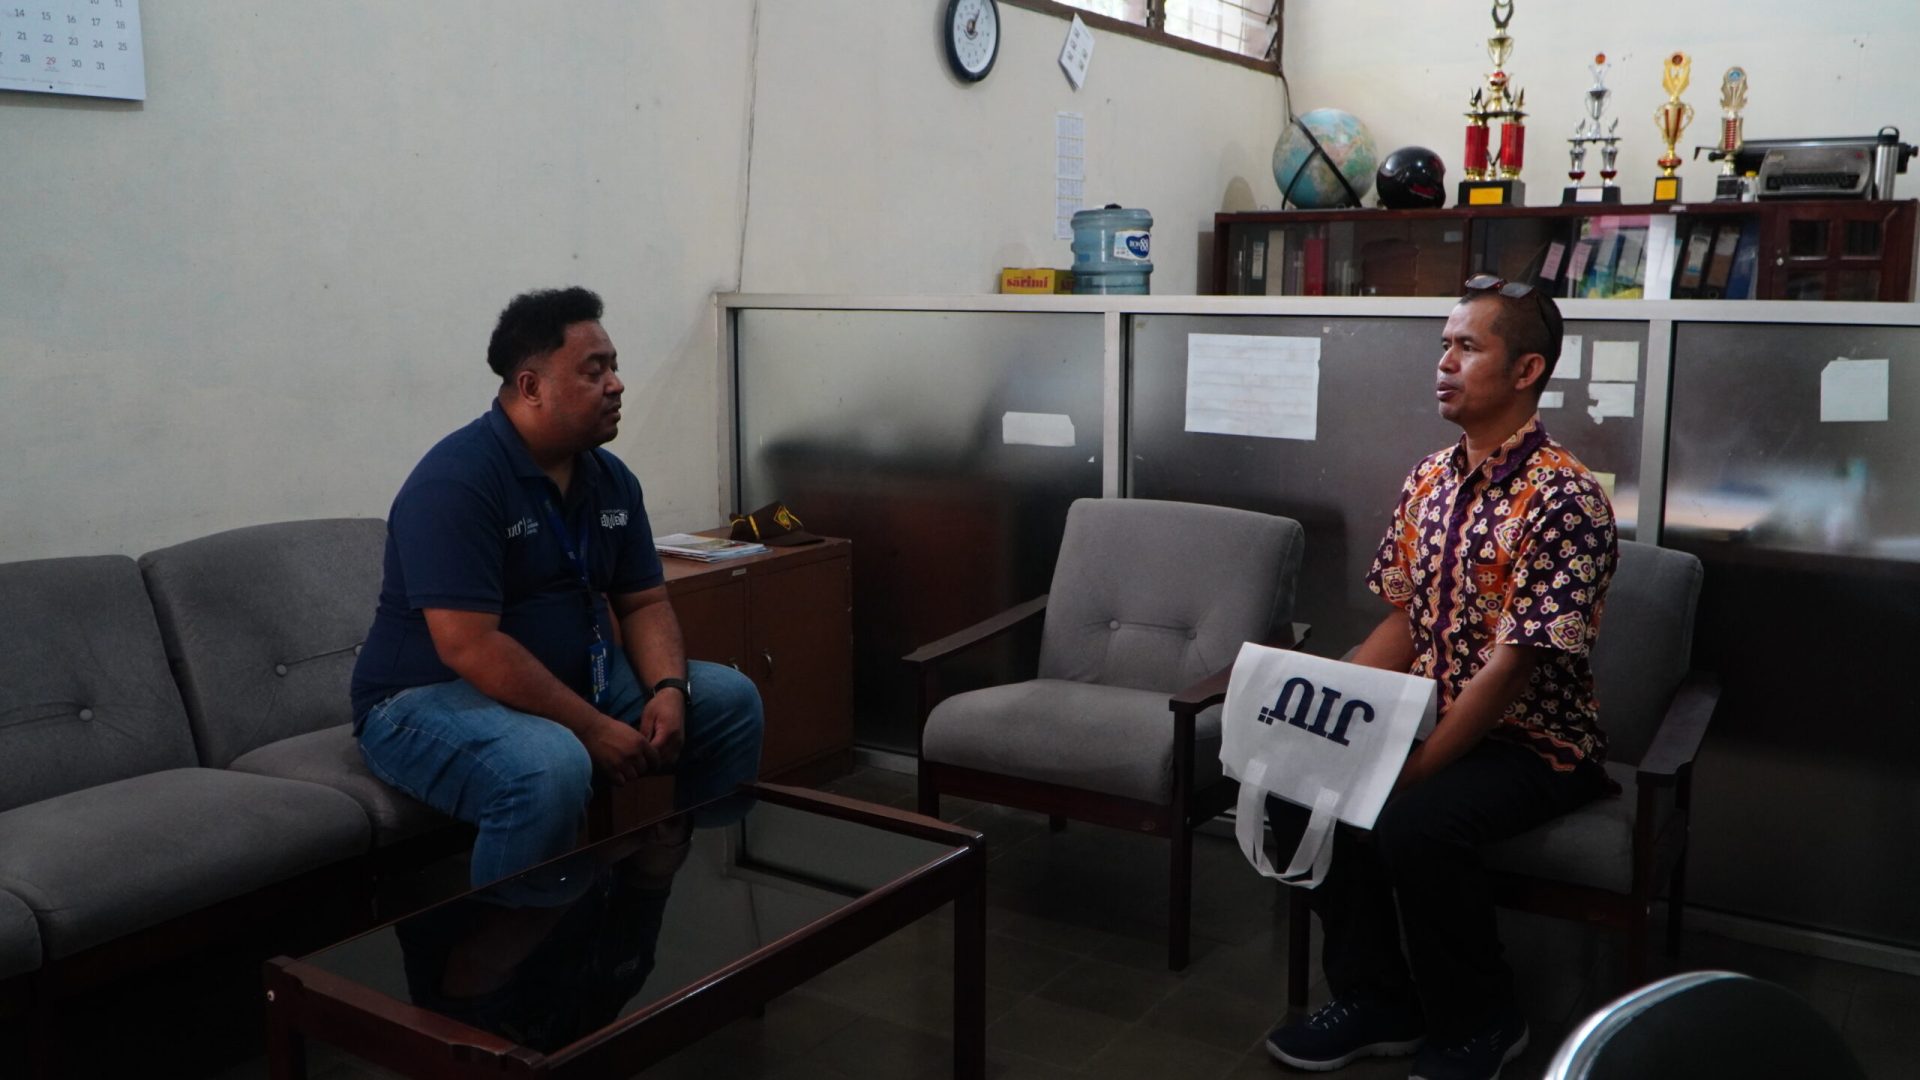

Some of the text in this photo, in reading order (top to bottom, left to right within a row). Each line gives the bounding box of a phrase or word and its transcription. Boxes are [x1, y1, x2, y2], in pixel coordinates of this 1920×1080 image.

[14, 9, 25, 18] 14
[41, 12, 51, 21] 15
[66, 15, 76, 24] 16
[91, 18, 101, 27] 17
[17, 32, 128, 51] 21 22 23 24 25
[20, 54, 105, 71] 28 29 30 31
[1006, 276, 1048, 289] sarimi
[1267, 677, 1375, 747] JIU
